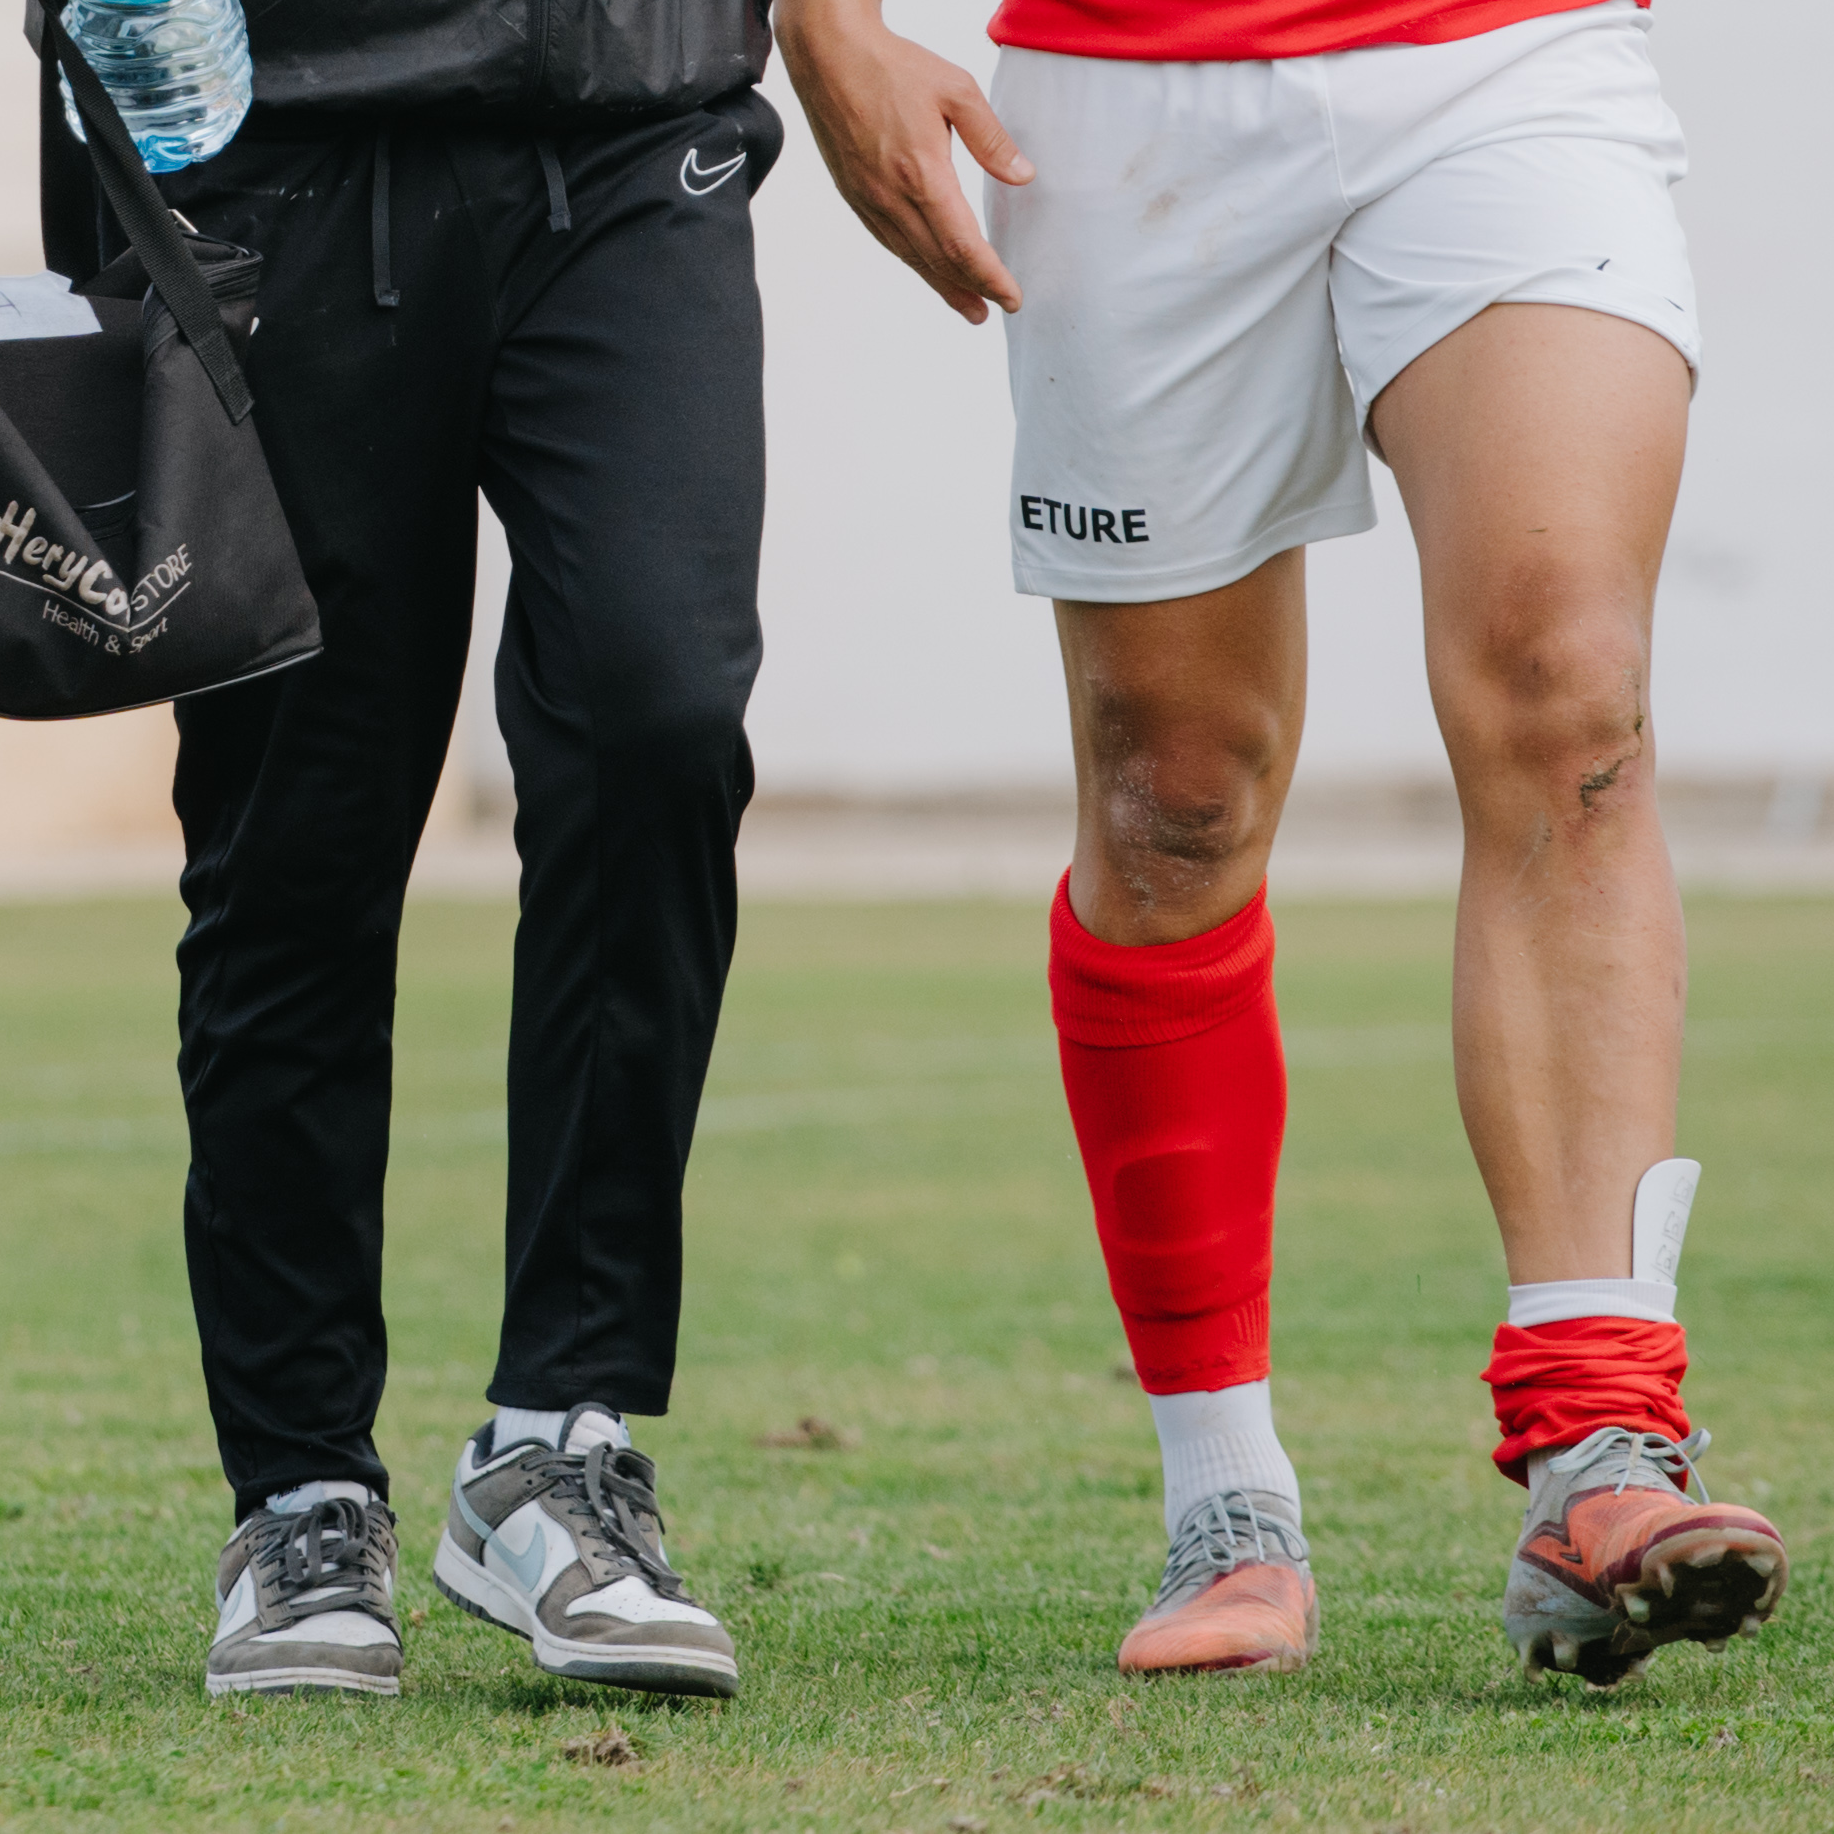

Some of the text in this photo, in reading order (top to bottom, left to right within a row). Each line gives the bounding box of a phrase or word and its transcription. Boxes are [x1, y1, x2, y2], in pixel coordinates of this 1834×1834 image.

[1020, 494, 1150, 544] ETURE
[130, 543, 193, 612] STORE
[42, 599, 169, 656] Health & Sport
